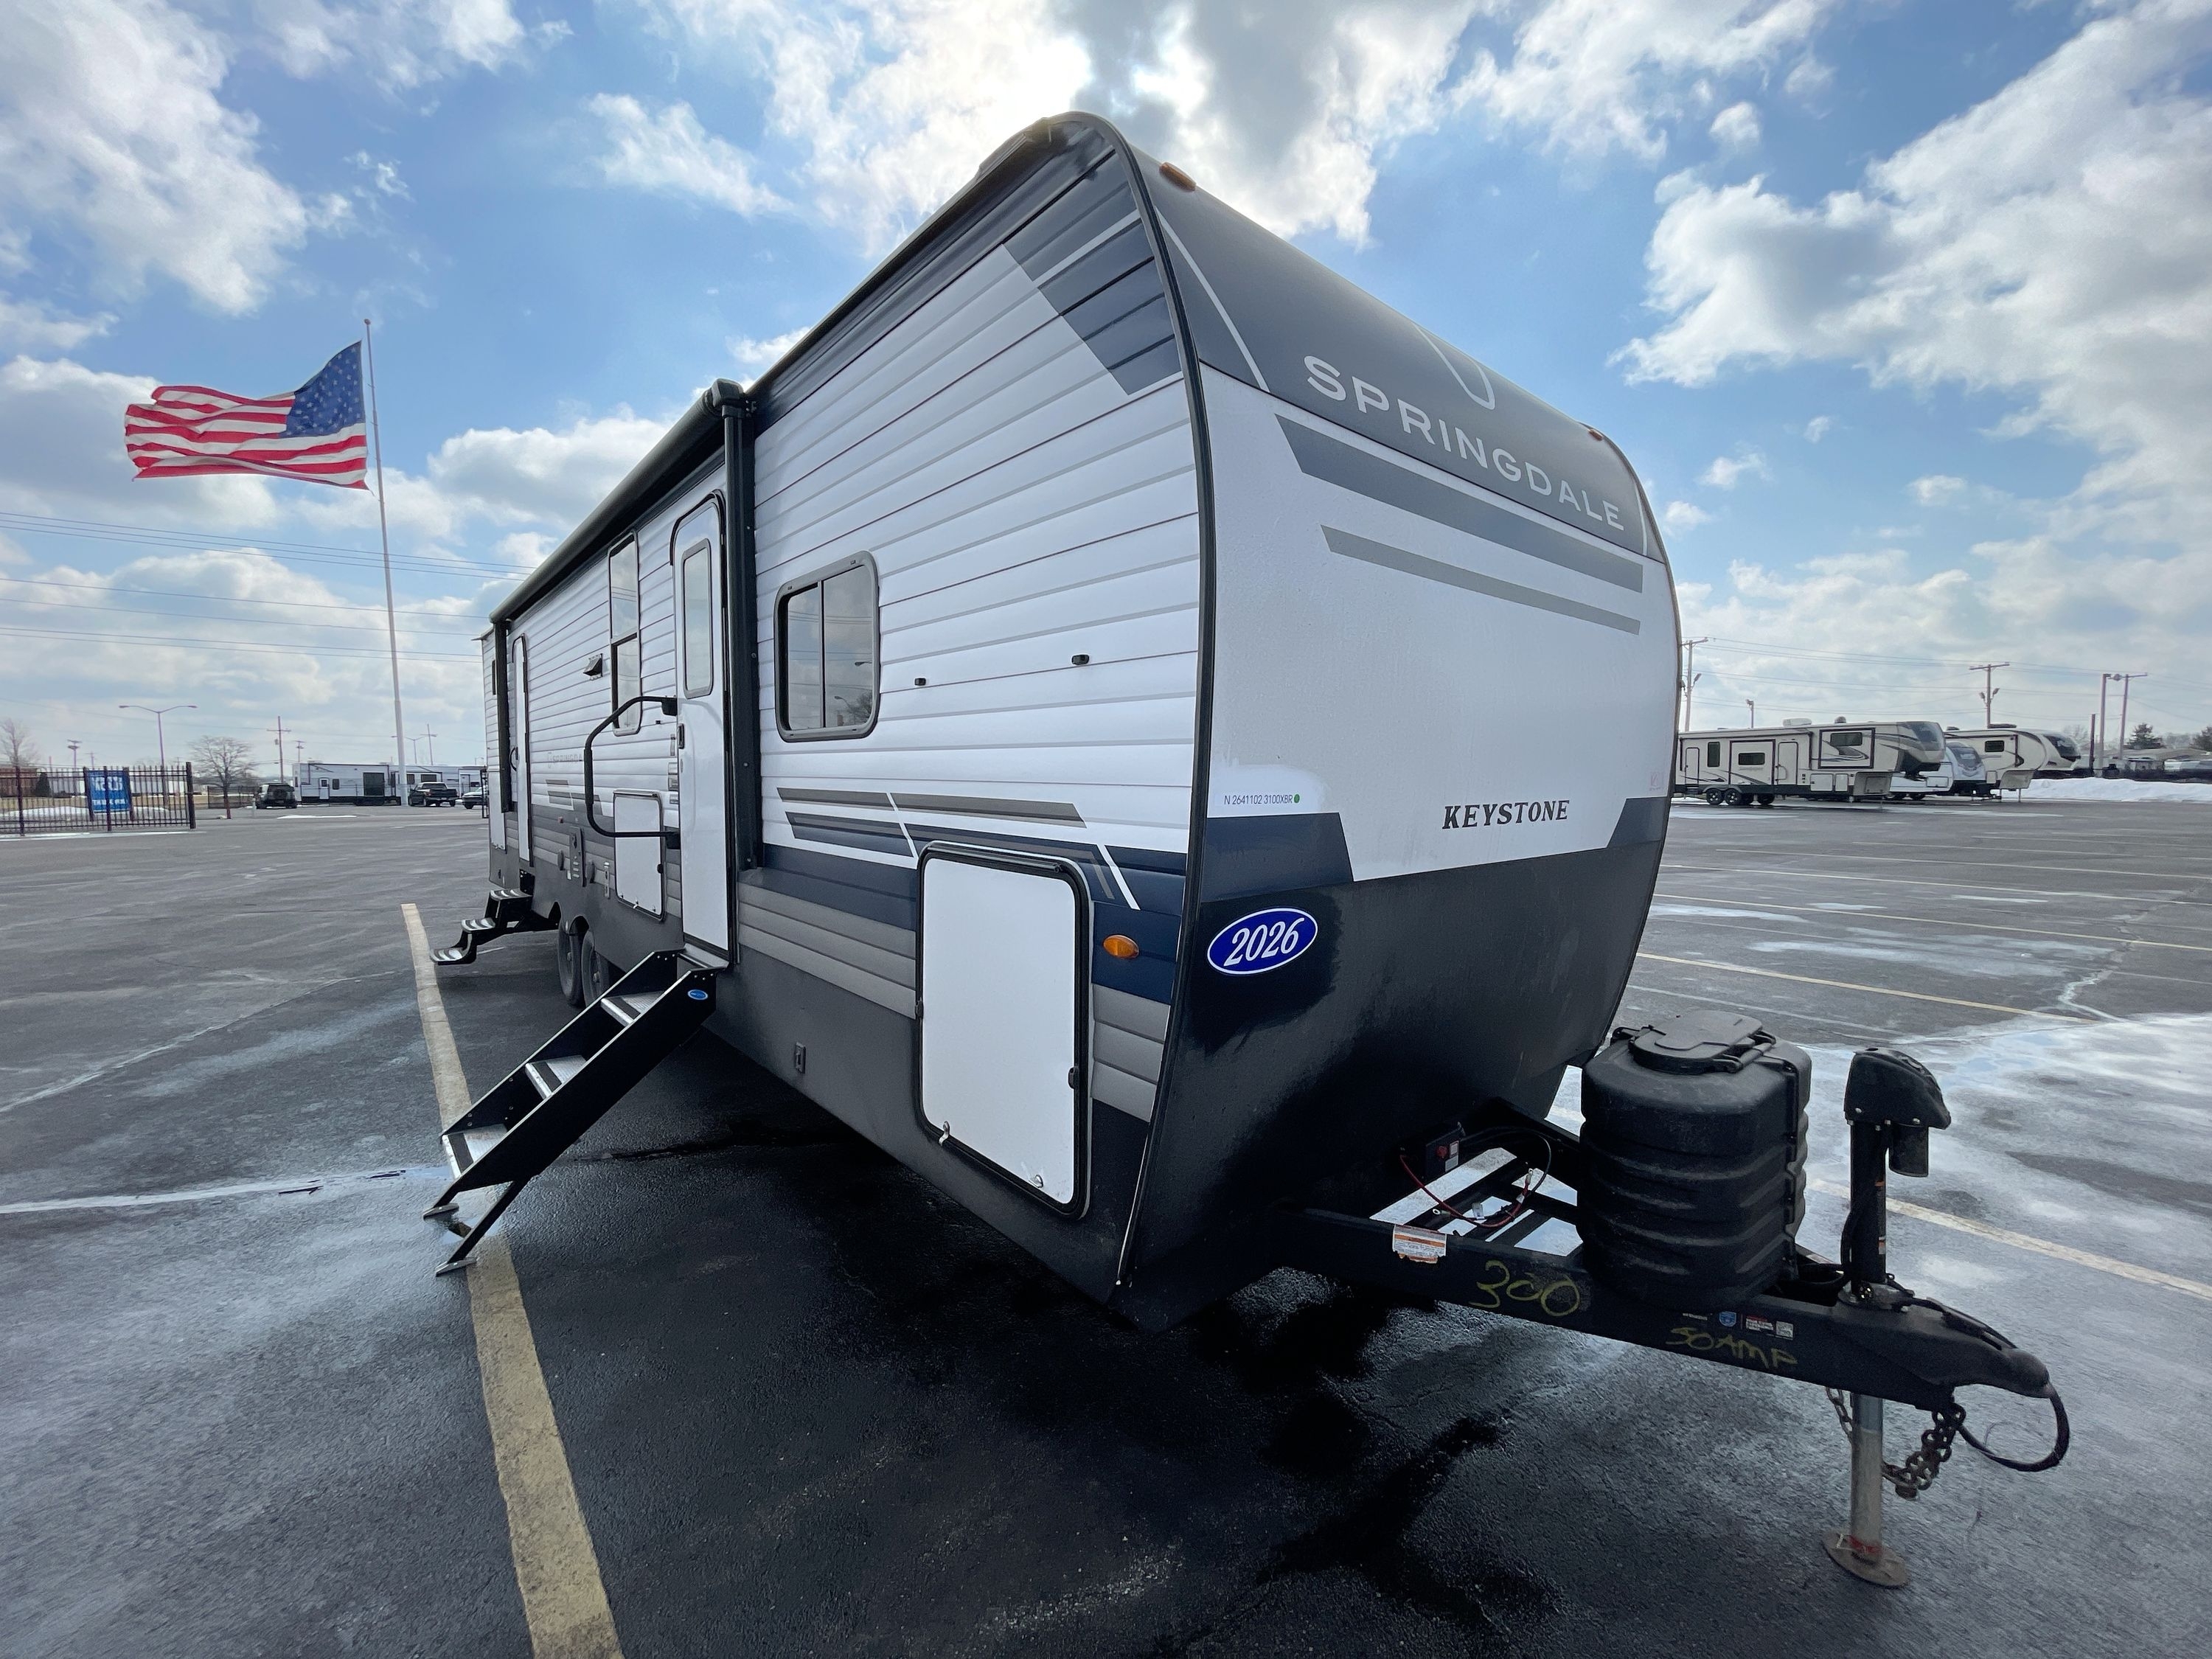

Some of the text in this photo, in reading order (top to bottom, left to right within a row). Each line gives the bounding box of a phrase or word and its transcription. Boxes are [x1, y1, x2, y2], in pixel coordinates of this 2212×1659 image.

[1304, 355, 1624, 531] SPRINGDALE
[1224, 796, 1231, 804] N
[1232, 795, 1262, 805] 2641102
[1442, 800, 1570, 830] KEYSTONE
[1223, 917, 1305, 967] 2026
[1468, 1259, 1580, 1317] 300
